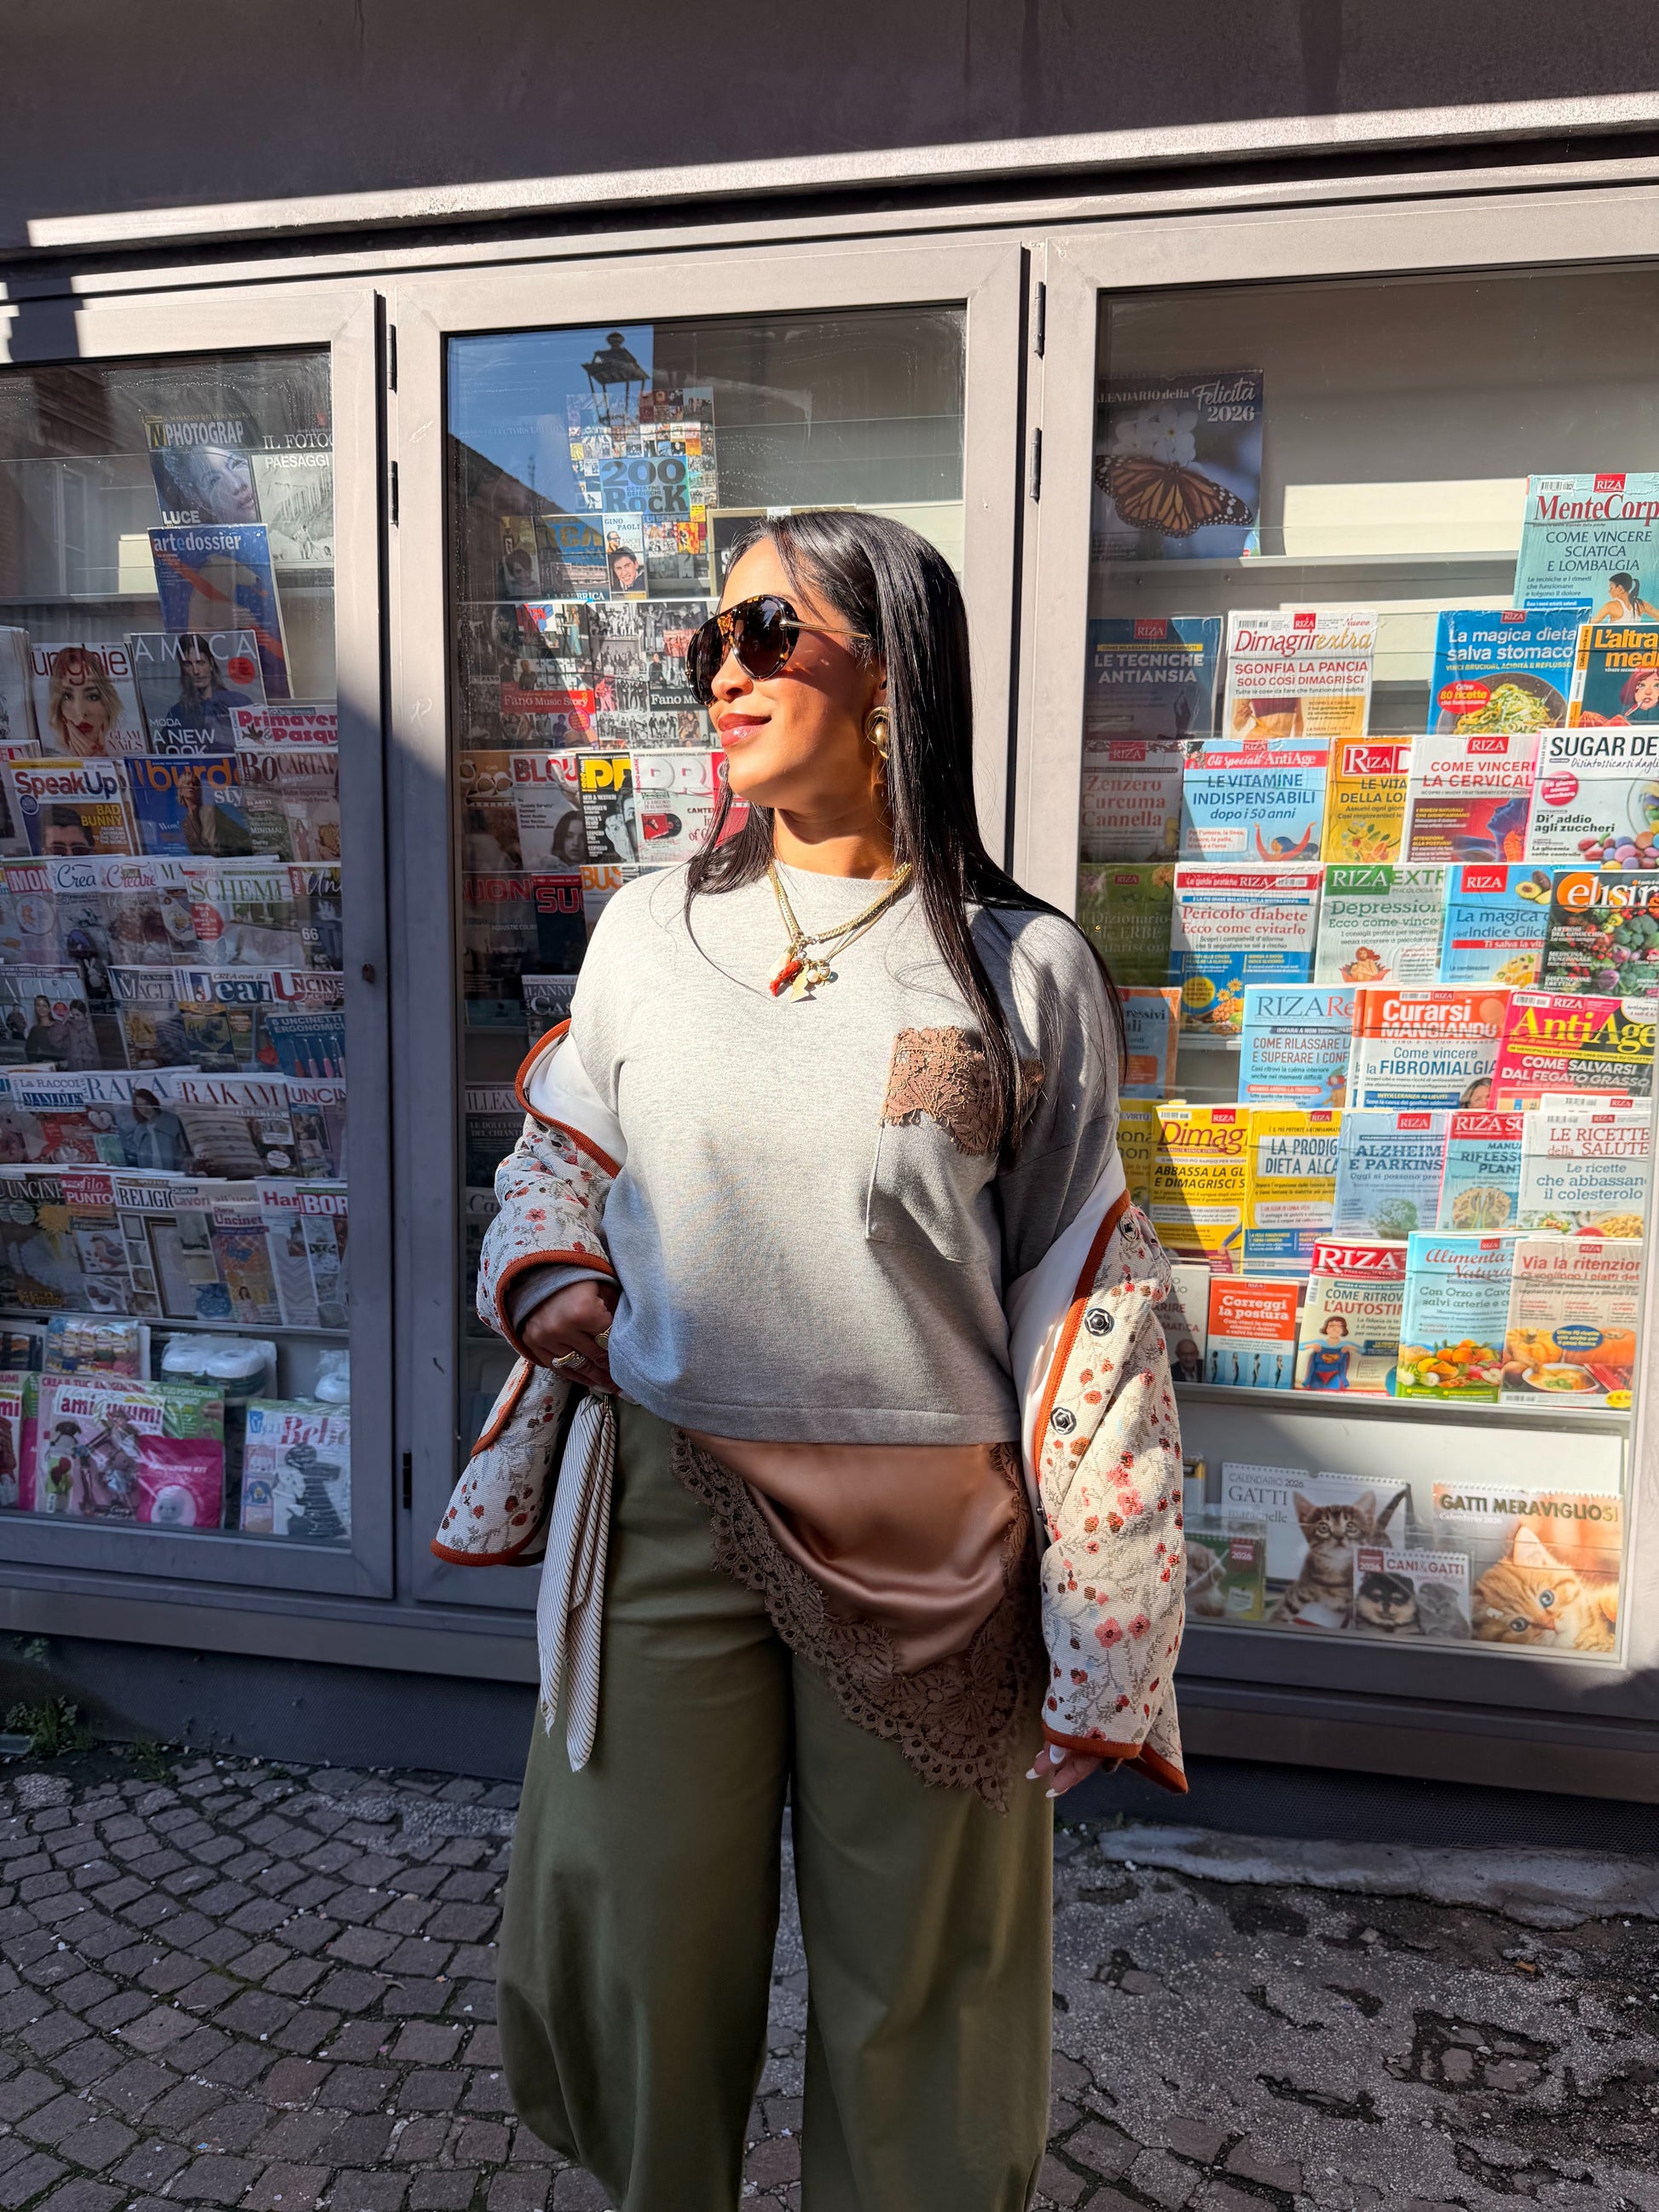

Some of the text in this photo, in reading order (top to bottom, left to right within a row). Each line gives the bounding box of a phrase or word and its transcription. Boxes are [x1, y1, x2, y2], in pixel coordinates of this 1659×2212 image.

[1162, 390, 1189, 400] della
[1192, 378, 1256, 410] Felicità
[1207, 406, 1255, 422] 2026
[165, 421, 244, 445] PHOTOGRAP
[263, 436, 280, 448] IL
[264, 454, 330, 468] PAESAGGI
[602, 459, 685, 486] 200
[162, 511, 201, 524] LUCE
[153, 532, 241, 552] artedossier
[1546, 530, 1652, 544] COME VINCERE
[1564, 546, 1627, 557] SCIATICA
[1547, 559, 1639, 572] E LOMBALGIA
[1449, 627, 1576, 644] La magica dieta
[1594, 629, 1659, 649] L'altra
[135, 634, 257, 661] AMICA
[1447, 645, 1574, 661] salva stomaco
[32, 644, 129, 685] unghie
[1094, 654, 1204, 667] LE TECNICHE
[1235, 661, 1368, 675] SGONFIA LA PANCIA
[1098, 669, 1198, 684] ANTIANSIA
[1237, 674, 1364, 687] SOLO COSÌ DIMAGRISCI
[505, 696, 533, 706] Fano
[535, 697, 561, 706] Music
[149, 719, 182, 727] MODA
[153, 729, 215, 744] A NEW
[1471, 739, 1505, 751] RIZA
[1550, 736, 1659, 757] SUGAR DE
[1266, 753, 1316, 767] AntiAge
[1344, 748, 1391, 773] RIZA
[1431, 762, 1473, 771] COME
[1571, 758, 1633, 769] Disintossicarsi
[14, 770, 118, 801] SpeakUp
[1087, 776, 1161, 792] Zenzero
[1208, 774, 1303, 788] LE VITAMINE
[1361, 779, 1375, 789] LE
[1422, 775, 1534, 788] LA CERVICAL
[1082, 794, 1166, 810] Curcuma
[1194, 792, 1315, 806] INDISPENSABILI
[96, 805, 120, 816] BAD
[1211, 809, 1240, 820] dopo
[1251, 809, 1265, 818] 50
[1268, 808, 1296, 819] anni
[81, 814, 123, 827] BUNNY
[1082, 811, 1162, 828] Cannella
[1536, 814, 1592, 823] Di' addio
[1535, 823, 1615, 833] agli zuccheri
[57, 863, 95, 888] Crea
[190, 875, 283, 902] SCHEMI
[1182, 906, 1308, 921] Pericolo diabete
[1456, 910, 1537, 925] La magica
[1182, 922, 1305, 934] Ecco come evitarlo
[1329, 919, 1358, 928] Ecco
[302, 927, 320, 941] 66
[1383, 999, 1471, 1022] Curarsi
[1380, 1021, 1497, 1038] MANGIANDO
[1512, 1007, 1656, 1054] AntiAge
[1253, 1037, 1339, 1050] COME RILASSARE
[1394, 1047, 1477, 1059] Come vincere
[1367, 1060, 1496, 1076] la FIBROMIALGIA
[1522, 1056, 1637, 1074] COME SALVARSI
[1500, 1067, 1650, 1087] DAL FEGATO GRASSO
[182, 1080, 280, 1106] RAKAM
[1550, 1127, 1650, 1141] LE RICETTE
[1271, 1139, 1288, 1155] LA
[1547, 1142, 1650, 1157] della SALUTE
[1266, 1158, 1301, 1174] DIETA
[1567, 1164, 1627, 1173] Le ricette
[1165, 1179, 1235, 1189] DIMAGRISCI
[1536, 1175, 1564, 1187] che
[66, 1190, 115, 1205] PUNTO
[1544, 1187, 1643, 1200] il colesterolo
[1523, 1256, 1548, 1269] Via
[1554, 1257, 1568, 1268] la
[1222, 1295, 1287, 1310] Correggi
[1422, 1297, 1489, 1308] salvi arterie
[1218, 1305, 1290, 1320] la postura
[1228, 1473, 1304, 1488] CALENDARIO 2026
[1228, 1486, 1287, 1505] GATTI
[1440, 1494, 1619, 1522] GATTI MERAVIGLIOSI
[1231, 1551, 1253, 1561] 2026
